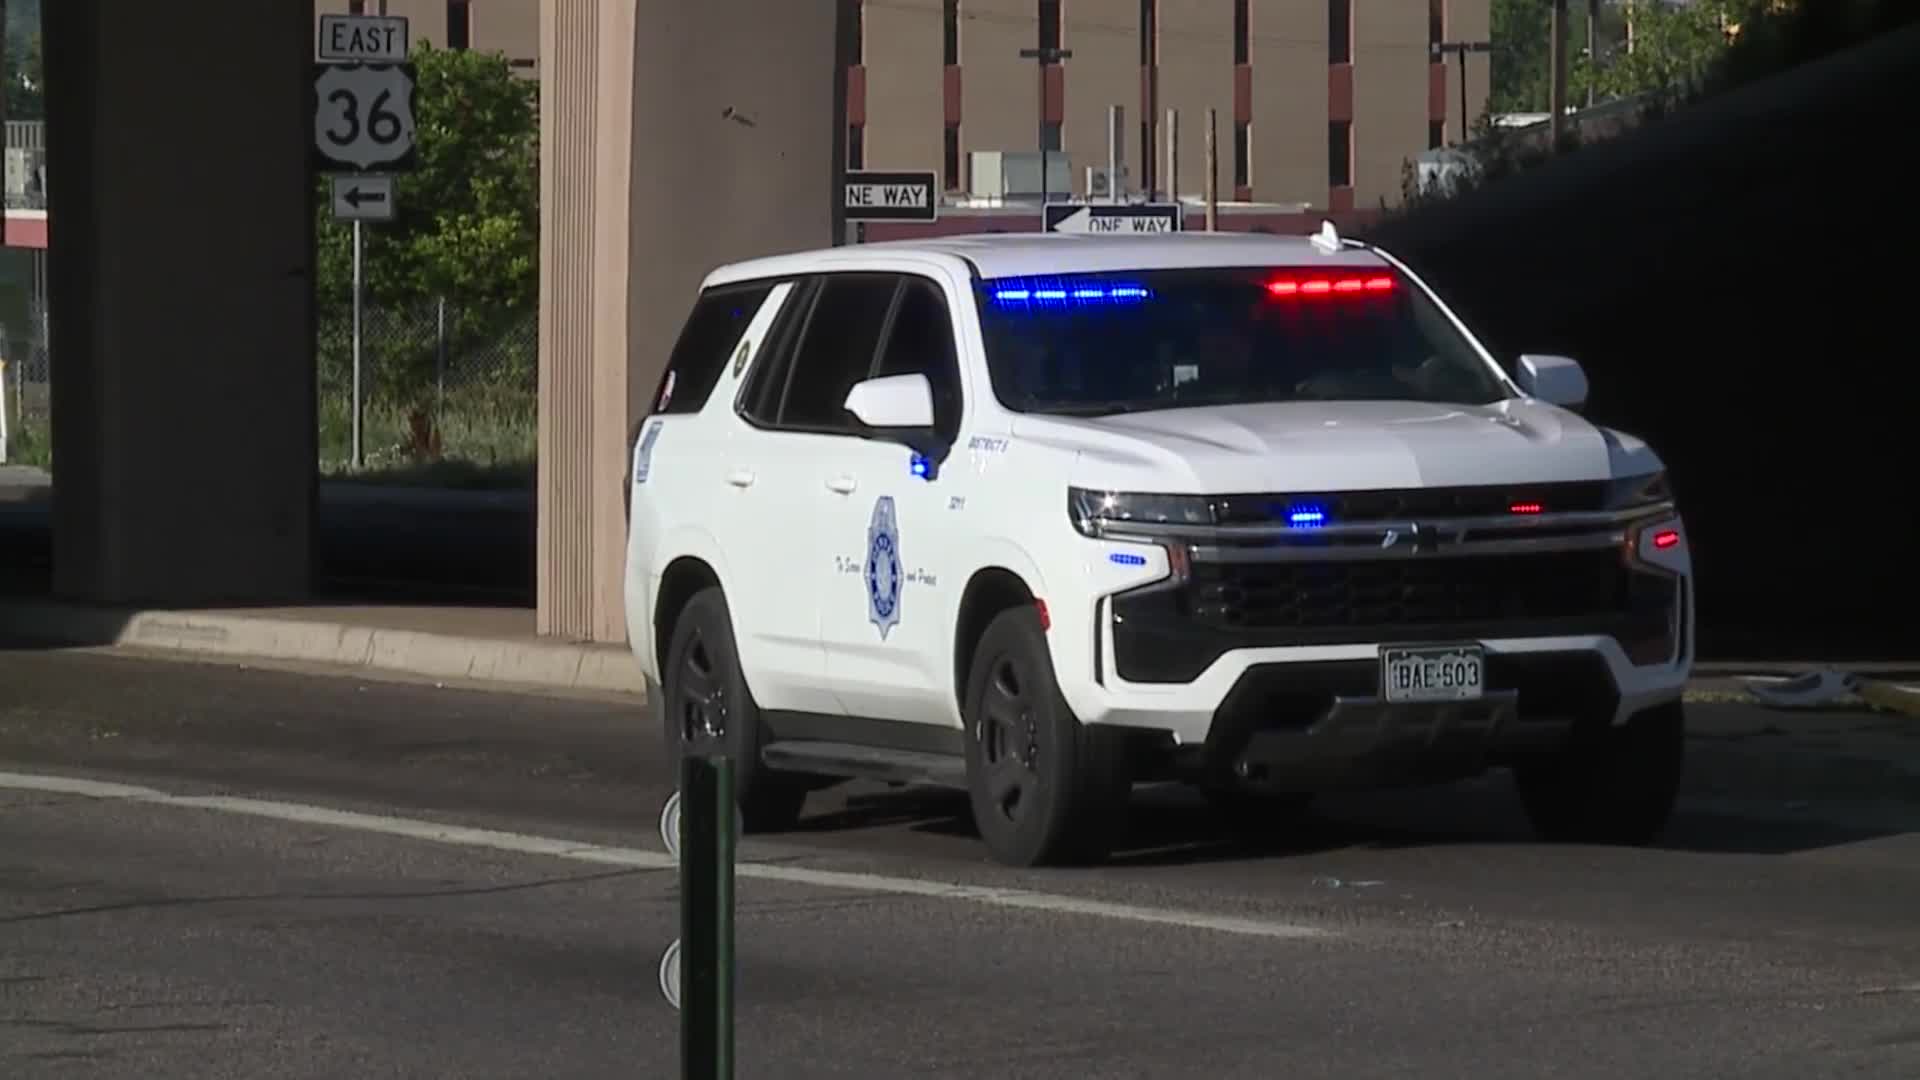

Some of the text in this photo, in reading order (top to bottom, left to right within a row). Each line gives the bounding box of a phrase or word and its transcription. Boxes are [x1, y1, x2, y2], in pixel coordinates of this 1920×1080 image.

[332, 23, 396, 54] EAST
[326, 88, 402, 146] 36
[848, 187, 923, 205] NE WAY
[1131, 217, 1168, 232] WAY
